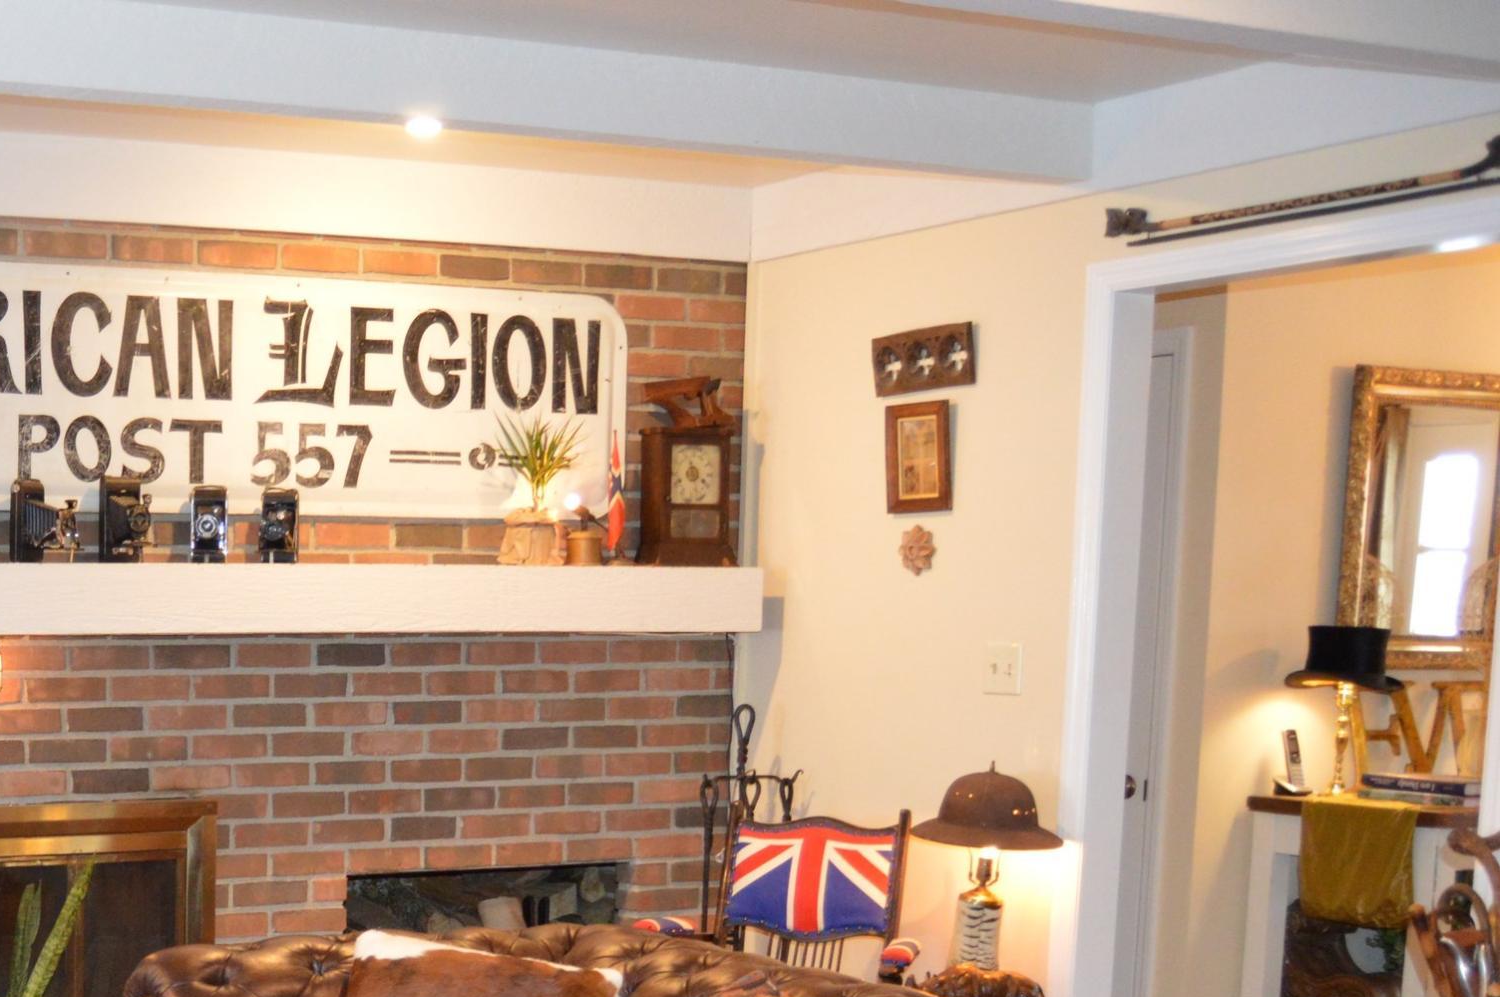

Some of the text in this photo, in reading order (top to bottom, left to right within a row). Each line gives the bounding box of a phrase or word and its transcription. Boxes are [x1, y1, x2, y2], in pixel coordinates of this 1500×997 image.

[256, 297, 601, 414] LEGION
[18, 414, 373, 489] POST 557
